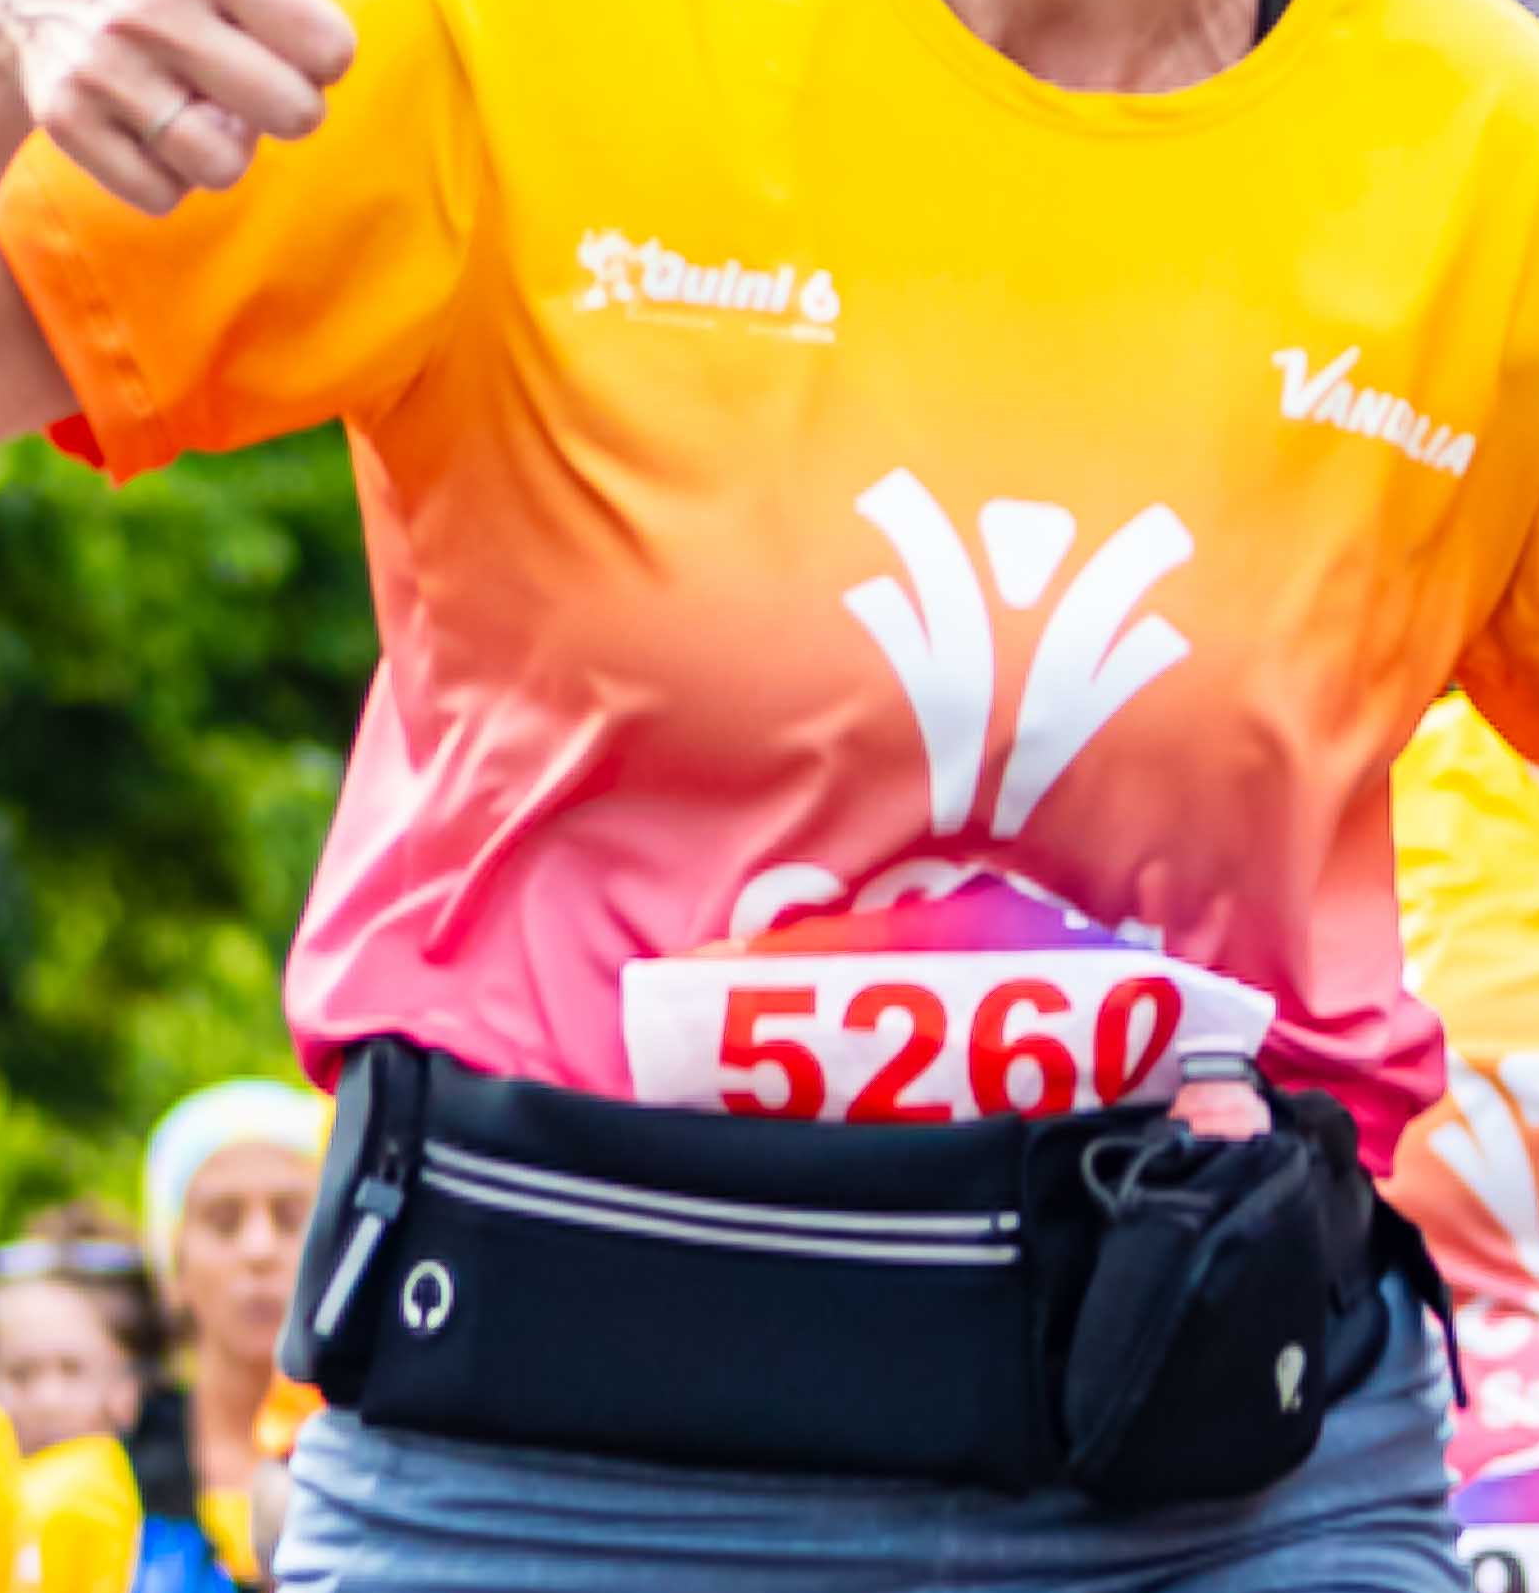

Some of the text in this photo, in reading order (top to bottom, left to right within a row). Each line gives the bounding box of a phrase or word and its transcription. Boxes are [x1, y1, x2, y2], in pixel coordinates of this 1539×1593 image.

[641, 243, 841, 324] Quini 6
[718, 974, 1182, 1124] 5260
